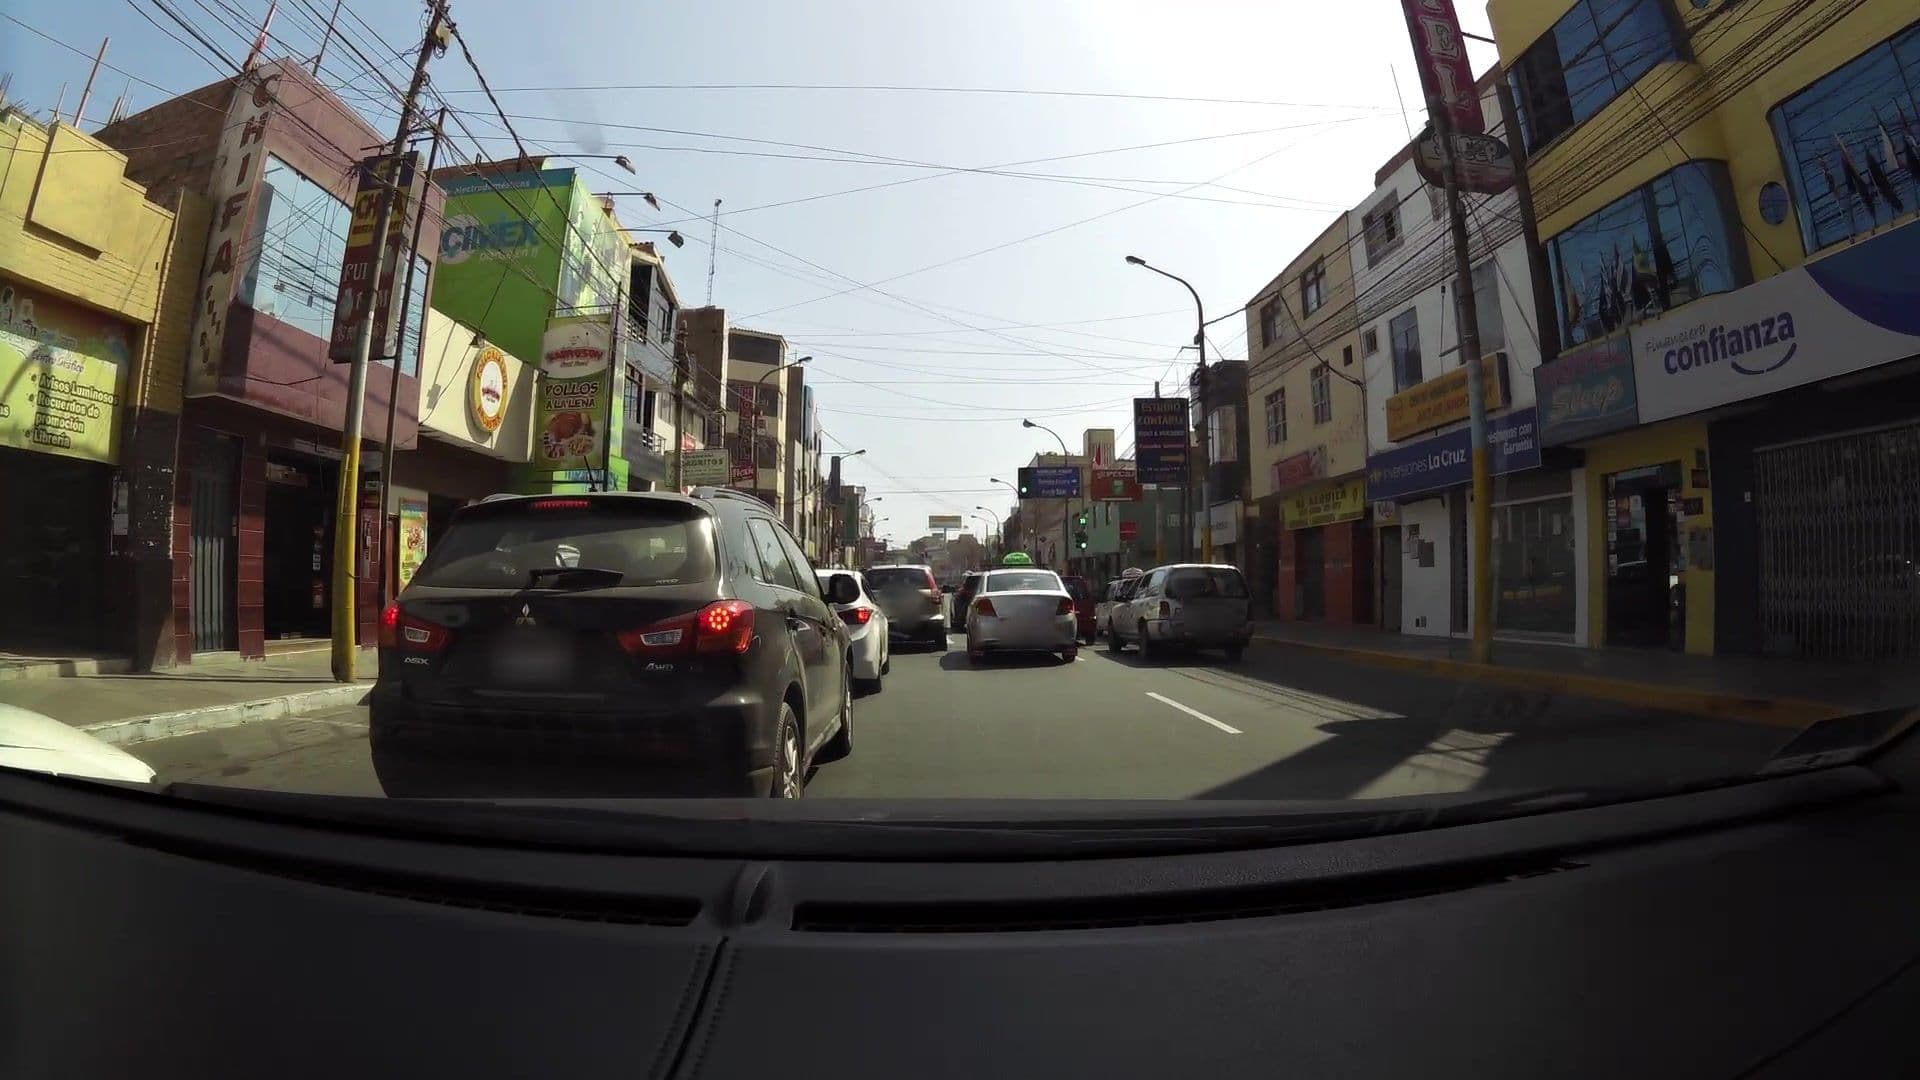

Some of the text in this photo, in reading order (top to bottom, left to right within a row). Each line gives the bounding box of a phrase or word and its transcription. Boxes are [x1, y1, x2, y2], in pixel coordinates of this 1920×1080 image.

[209, 73, 281, 277] CHIFA
[1664, 311, 1796, 375] confianza
[39, 373, 119, 405] Avisos Luminosos
[546, 382, 598, 396] POLLOS
[37, 390, 100, 418] Recuerdos de
[35, 411, 85, 433] promoción
[32, 428, 71, 448] Librería
[1428, 453, 1440, 470] La
[1441, 448, 1467, 466] Cruz
[404, 657, 430, 665] ASX
